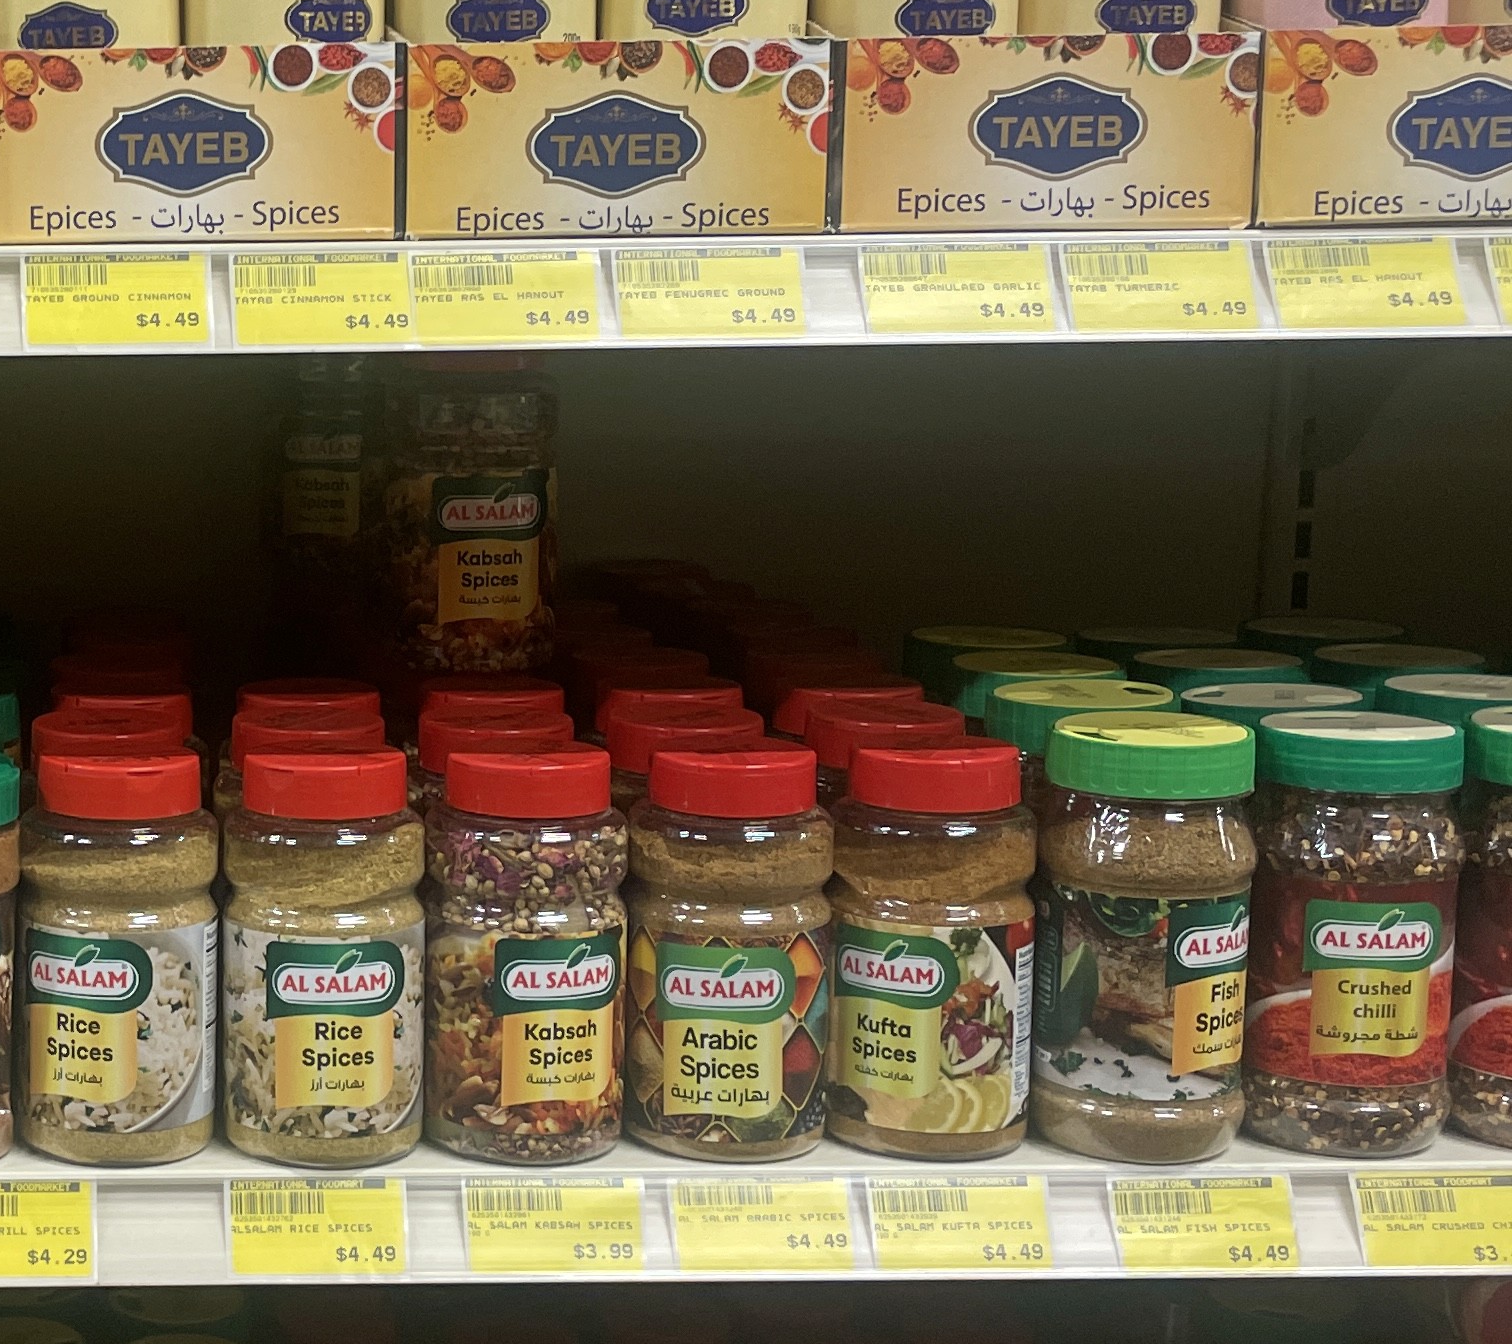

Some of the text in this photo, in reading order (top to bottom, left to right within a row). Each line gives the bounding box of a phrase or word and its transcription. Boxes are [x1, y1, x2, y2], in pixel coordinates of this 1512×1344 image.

[118, 132, 250, 167] TAYEB
[549, 133, 682, 167] TAYEB
[457, 203, 770, 235] Epices بهارات Spices
[980, 301, 1045, 318] $4.49
[456, 550, 523, 569] Kabsah
[460, 571, 519, 592] Spices
[1337, 979, 1413, 996] Crushed
[1353, 1001, 1397, 1019] chilli
[682, 1027, 758, 1051] Arabic
[680, 1055, 760, 1083] Spices
[671, 1085, 770, 1109] بهارات عربية
[982, 1244, 1044, 1261] $4.49
